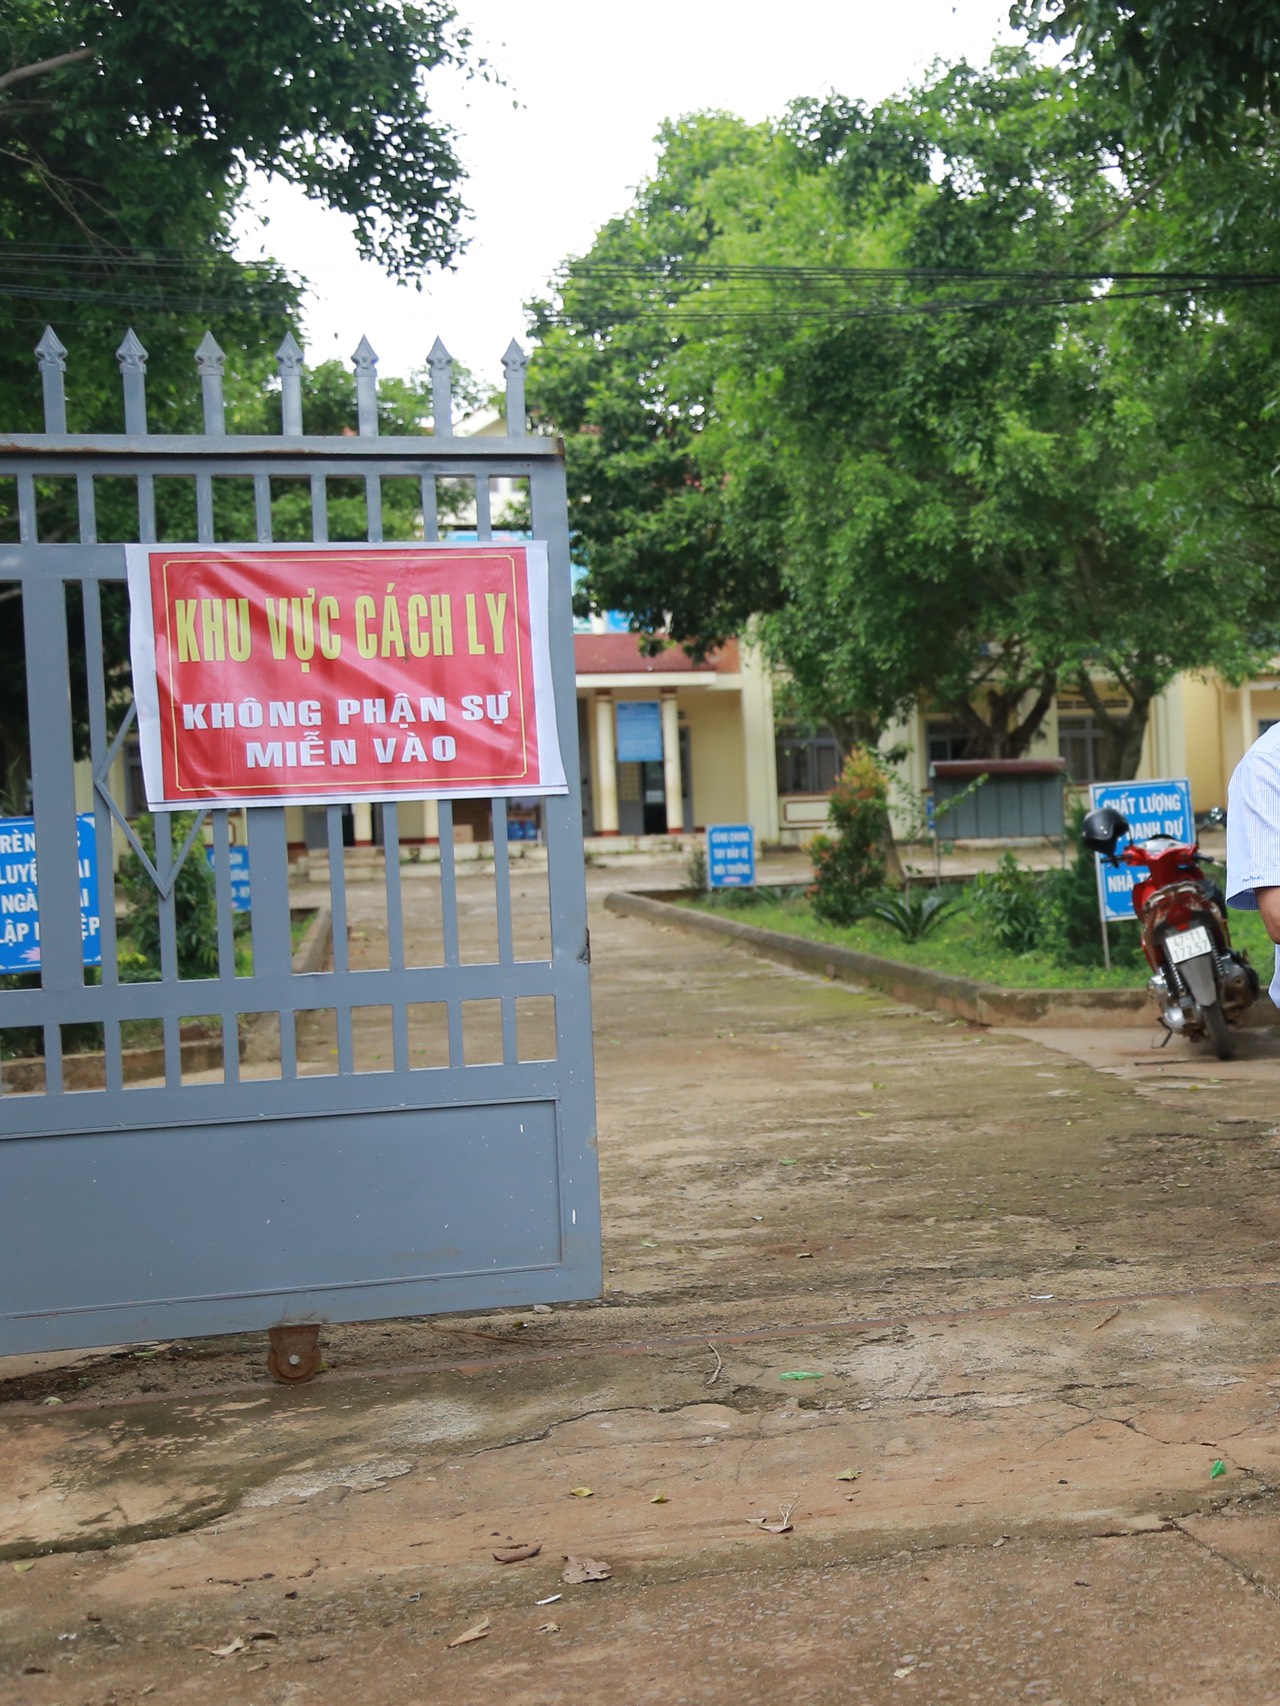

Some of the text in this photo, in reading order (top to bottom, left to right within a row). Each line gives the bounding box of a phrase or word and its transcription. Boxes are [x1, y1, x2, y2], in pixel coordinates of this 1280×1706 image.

[175, 583, 507, 673] KHU VỰC CÁCH LY
[183, 691, 512, 730] KHÔNG PHẬN SỰ
[246, 731, 456, 768] MIỄN VÀO
[1139, 793, 1181, 816] LƯỢNG
[1108, 870, 1134, 893] NHÀ
